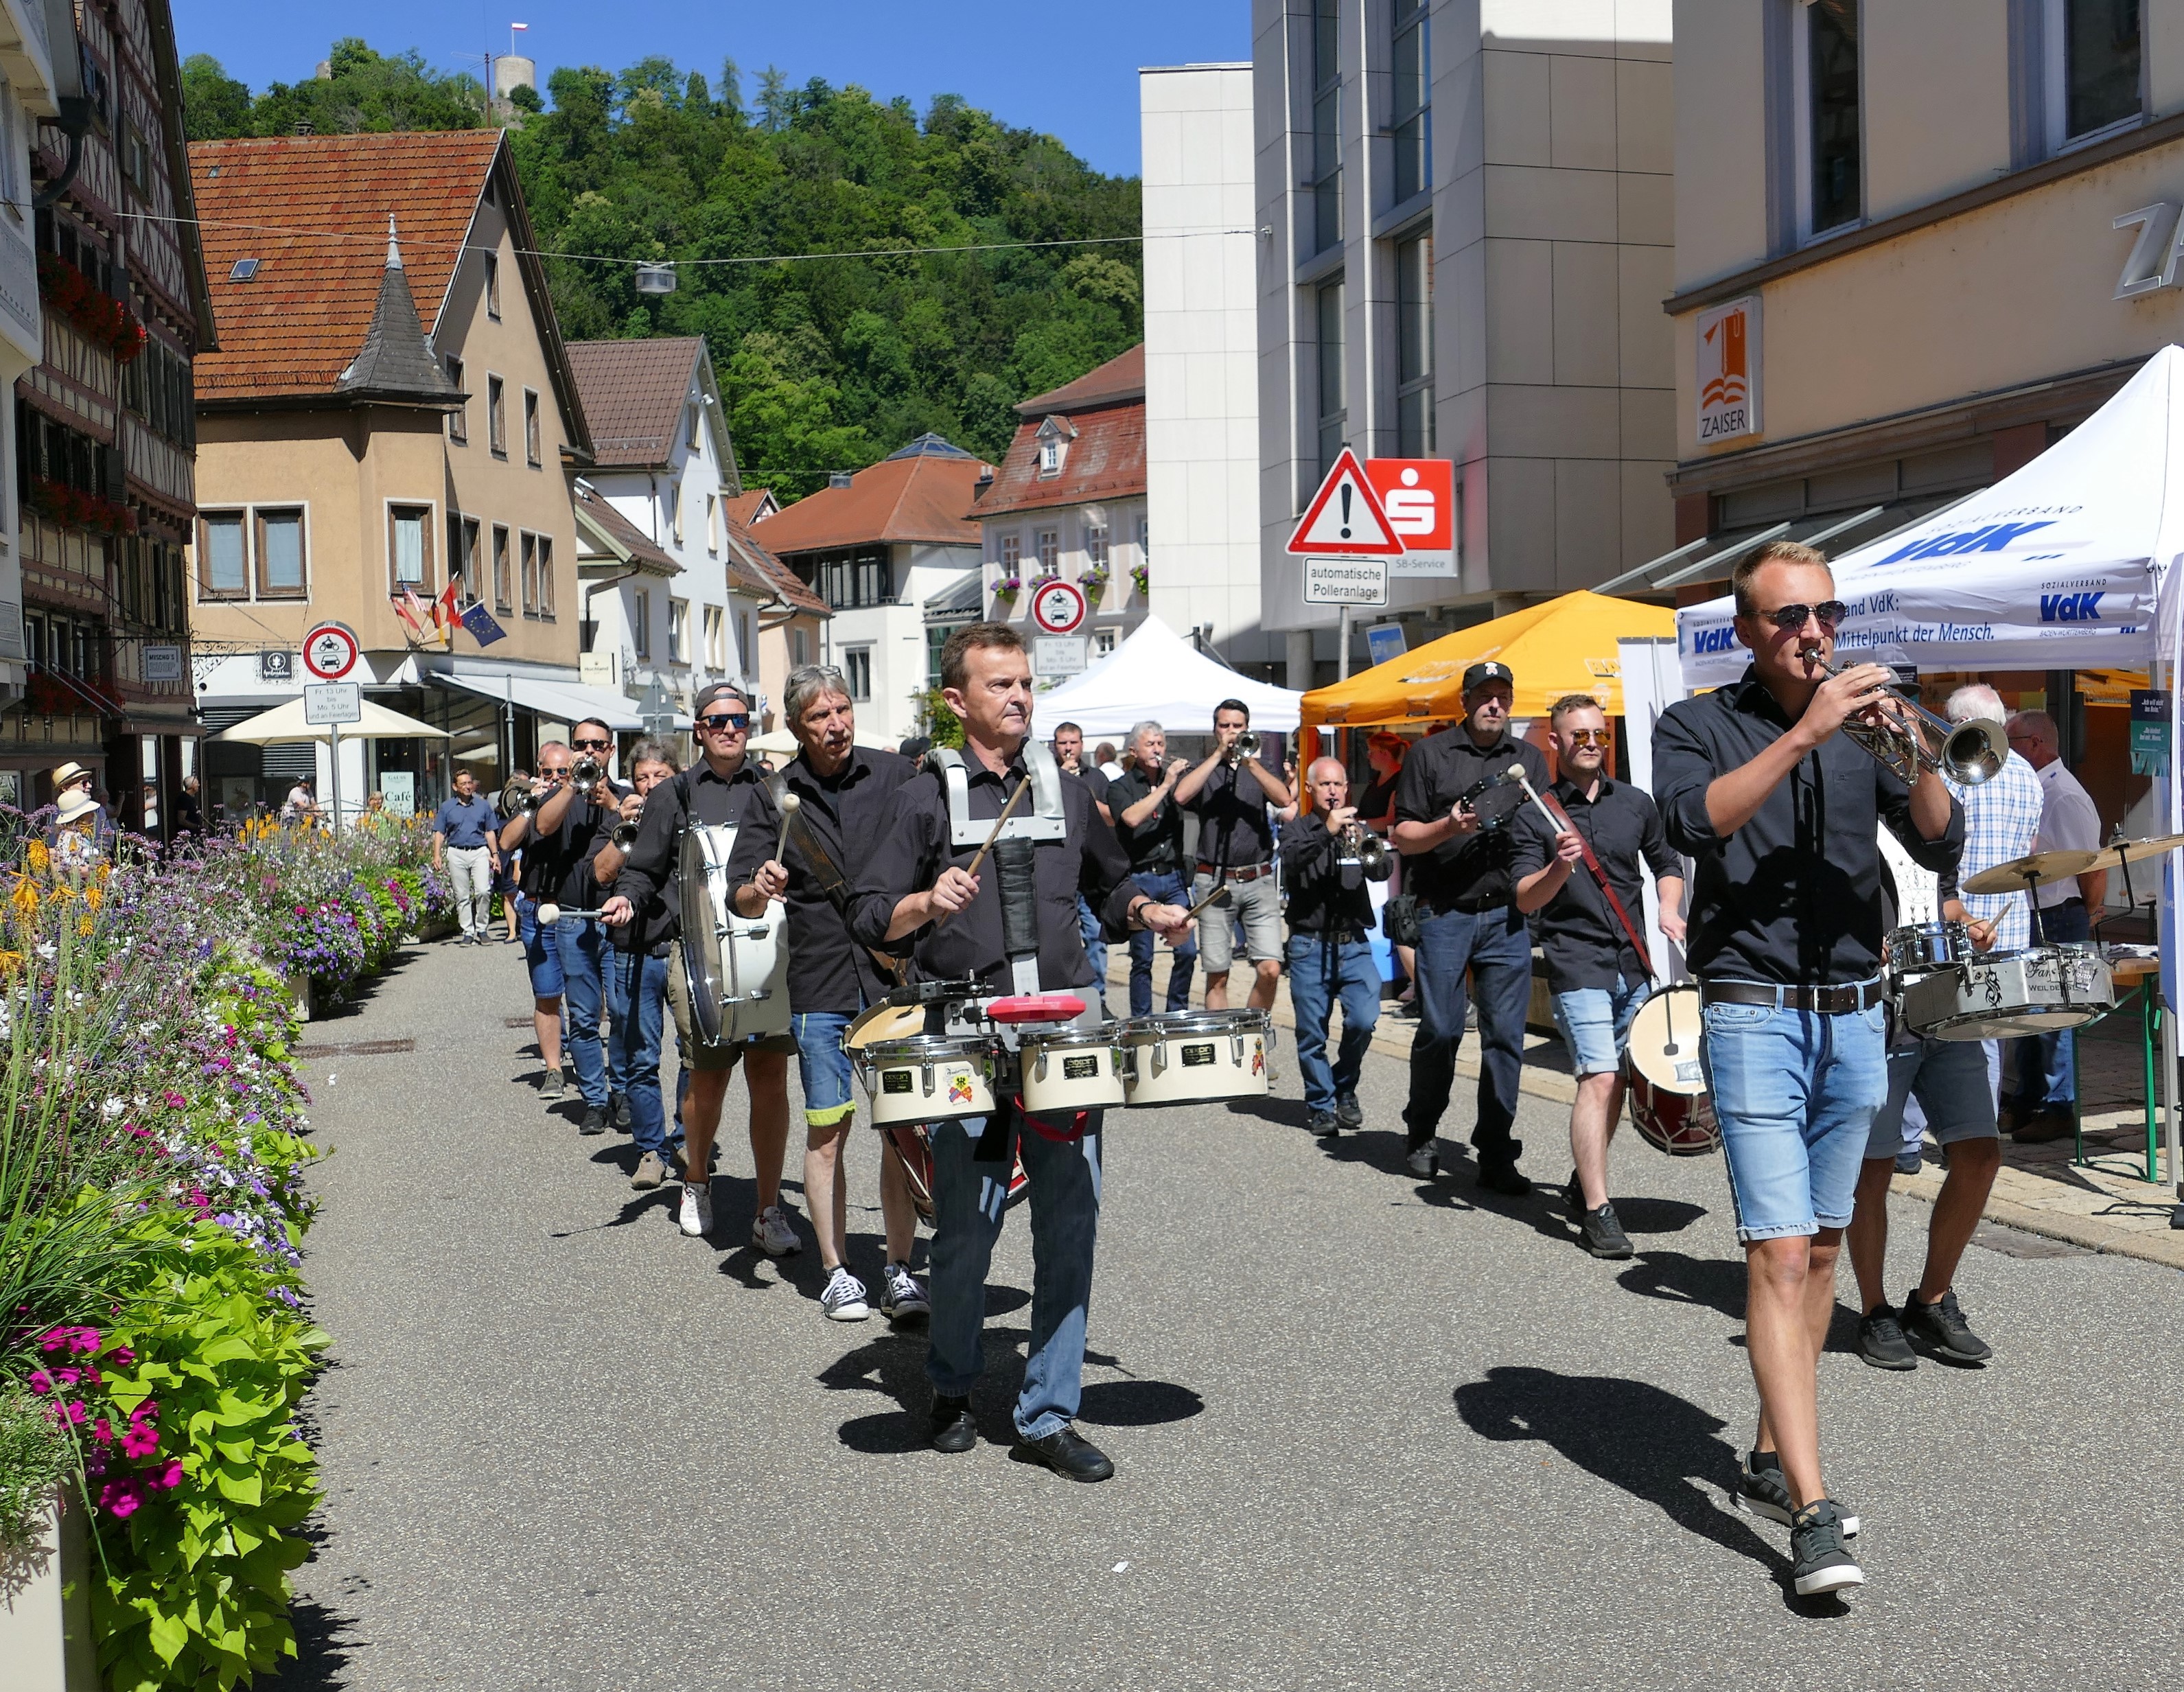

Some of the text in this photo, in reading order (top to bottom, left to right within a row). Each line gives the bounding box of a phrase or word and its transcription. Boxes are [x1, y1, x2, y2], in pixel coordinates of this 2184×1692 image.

[1702, 409, 1745, 438] ZAISER
[1869, 520, 2060, 568] VdK
[1311, 568, 1382, 581] automatische
[1395, 559, 1445, 569] SB-Service
[1313, 583, 1378, 601] Polleranlage
[2041, 579, 2106, 590] SOZIALVERBAND
[1870, 593, 1899, 614] VdK:
[2041, 591, 2106, 622] VdK
[1694, 627, 1736, 654] VdK
[1835, 622, 1995, 650] Mittelpunkt der Mensch.
[385, 790, 411, 802] Café
